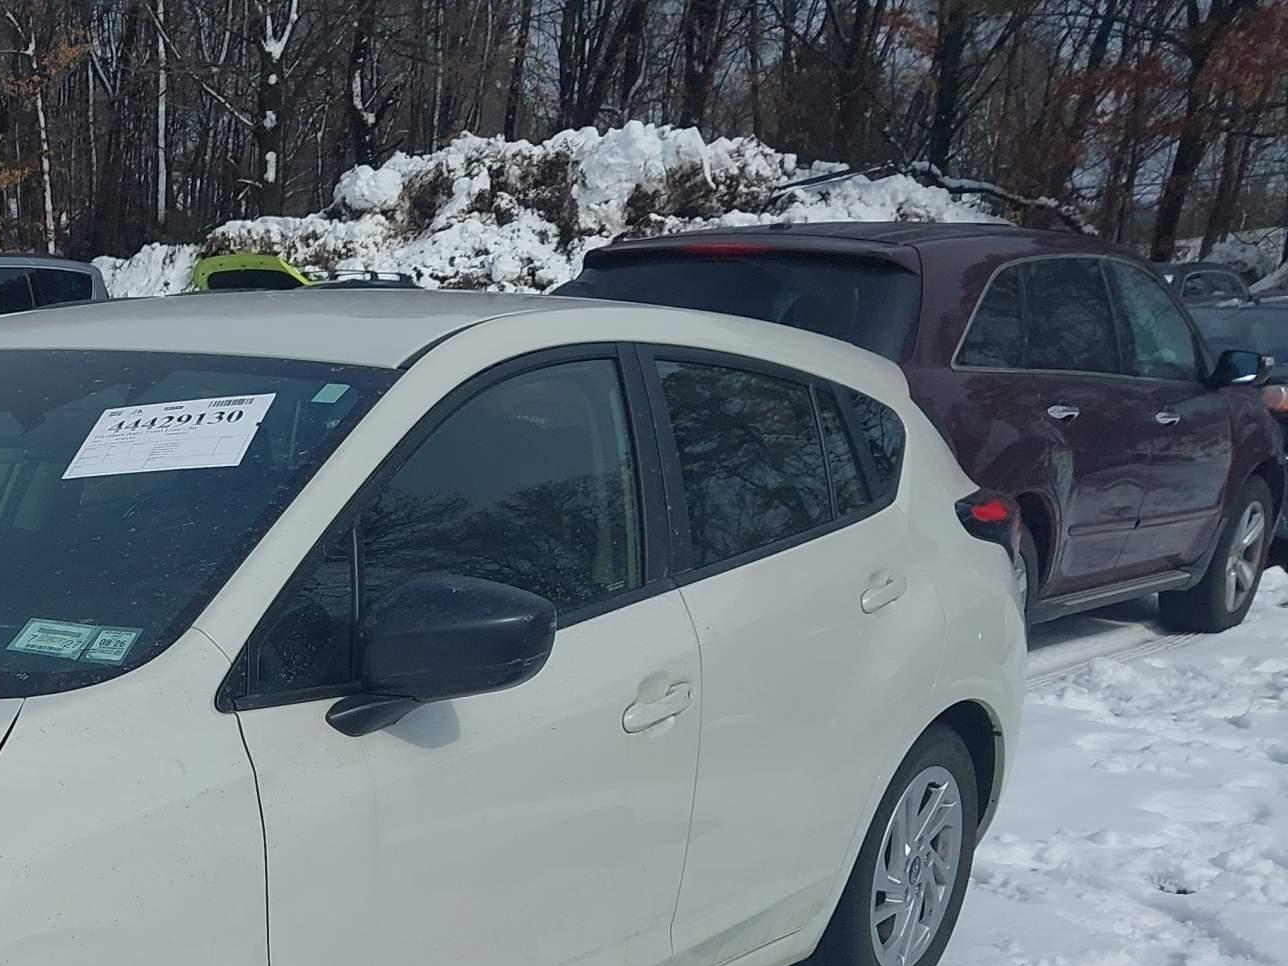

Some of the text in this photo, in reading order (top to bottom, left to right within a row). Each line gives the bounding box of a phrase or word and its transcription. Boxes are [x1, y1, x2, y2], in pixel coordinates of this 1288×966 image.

[108, 409, 244, 433] 44429130
[62, 639, 82, 649] 27
[113, 640, 127, 648] 26
